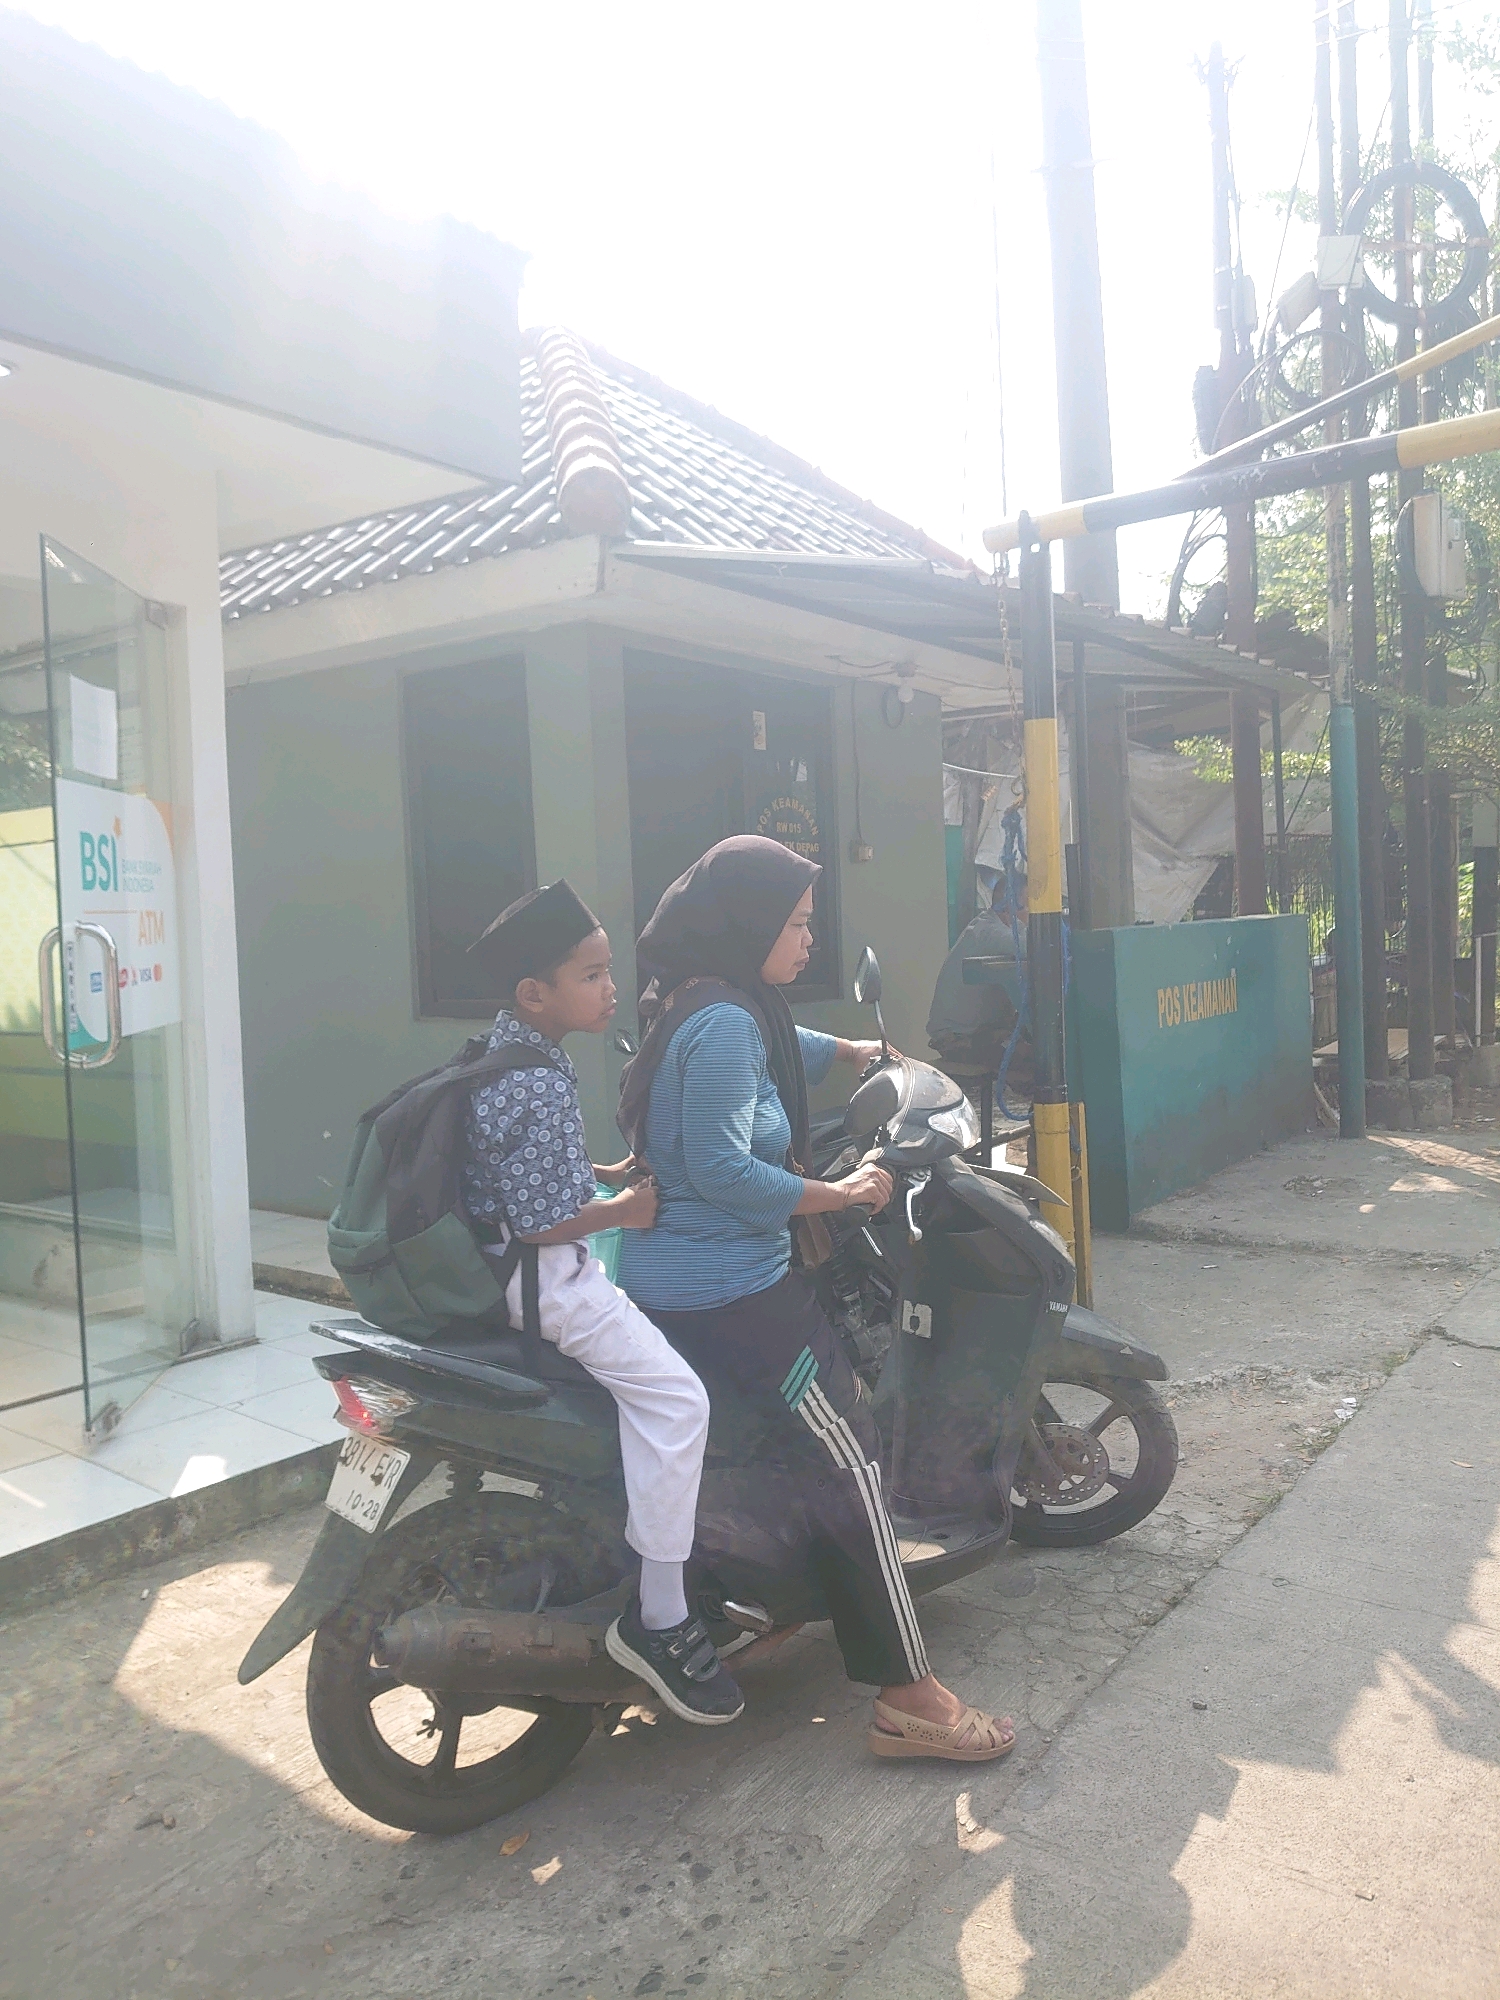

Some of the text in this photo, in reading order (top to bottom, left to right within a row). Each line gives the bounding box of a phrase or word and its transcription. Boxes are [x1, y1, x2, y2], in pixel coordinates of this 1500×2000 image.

[757, 797, 819, 836] POS KEAMANAN
[80, 830, 118, 892] BSI
[138, 909, 165, 946] ATM
[1157, 976, 1238, 1029] POS KEAMANAN
